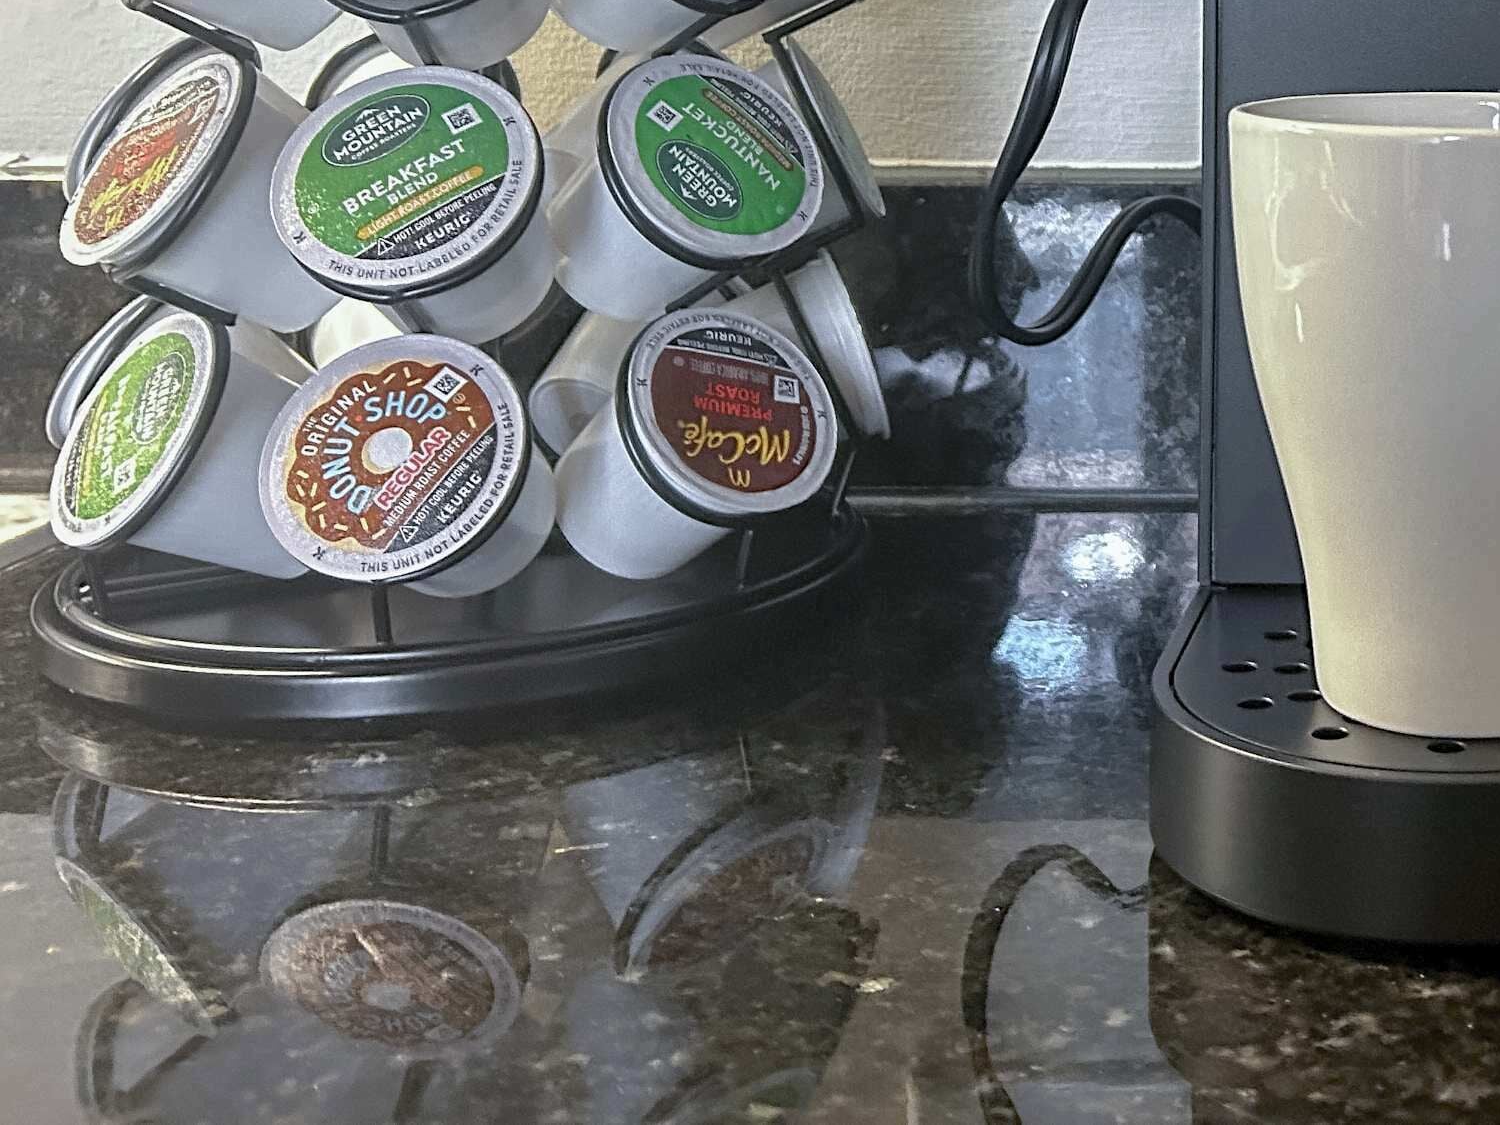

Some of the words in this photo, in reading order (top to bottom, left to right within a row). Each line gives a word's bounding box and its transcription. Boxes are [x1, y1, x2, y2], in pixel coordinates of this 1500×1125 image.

[341, 104, 401, 143] GREEN
[740, 91, 784, 127] KEURIG
[333, 107, 423, 162] MOUNTAIN
[350, 139, 384, 161] COFFEE
[682, 101, 781, 192] NANTUCKET
[725, 119, 762, 156] BLEND
[342, 138, 466, 215] BREAKFAST
[387, 172, 438, 206] BLEND
[668, 145, 738, 209] MOUNTAIN
[672, 163, 718, 208] GREEN
[328, 259, 353, 277] THIS
[356, 266, 385, 280] UNIT
[391, 266, 415, 278] NOT
[418, 243, 471, 275] LABELED
[472, 223, 494, 245] FOR
[491, 187, 517, 222] RETAIL
[510, 159, 523, 186] SALE
[367, 211, 398, 235] LIGHT
[397, 190, 436, 219] ROAST
[394, 225, 415, 245] HOT!
[414, 215, 435, 232] COOL
[434, 201, 464, 223] BEFORE
[462, 183, 498, 207] PEELING
[415, 213, 469, 250] KEURIG
[704, 329, 752, 346] KEURIG
[693, 396, 774, 421] PREMIUM
[705, 381, 761, 404] ROAST
[301, 380, 377, 457] ORIGINAL
[497, 401, 514, 435] SALE
[683, 415, 791, 466] McCafé
[321, 418, 369, 514] DONUT
[363, 390, 447, 424] SHOP
[373, 427, 452, 512] REGULAR
[502, 434, 515, 473] RETAIL
[383, 488, 417, 528] MEDIUM
[415, 459, 442, 491] ROAST
[440, 429, 471, 465] COFFEE
[413, 504, 432, 526] HOT!
[428, 482, 449, 507] COOL
[446, 459, 470, 488] BEFORE
[465, 434, 495, 467] PEELING
[437, 470, 482, 526] KEURIG
[490, 472, 507, 500] FOR
[450, 497, 495, 544] LABELED
[360, 561, 389, 573] THIS
[392, 552, 422, 571] UNIT
[424, 540, 450, 560] NOT
